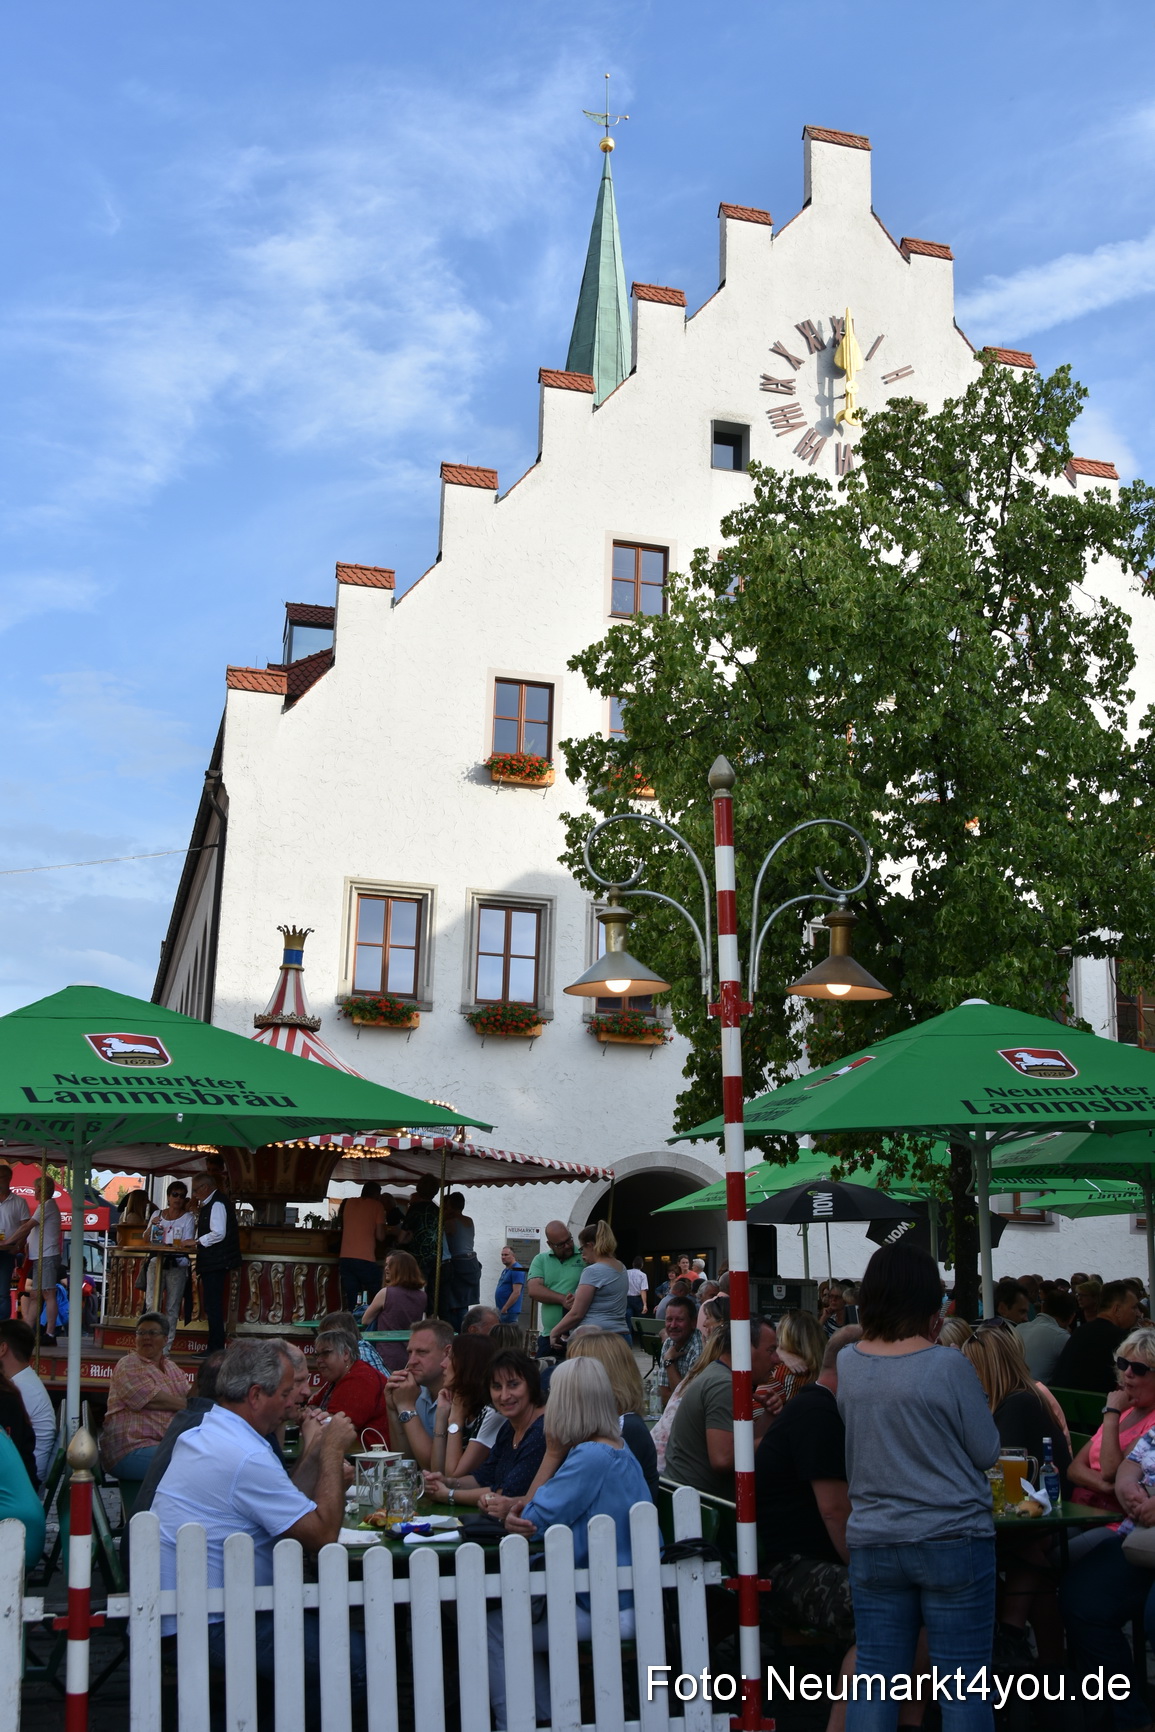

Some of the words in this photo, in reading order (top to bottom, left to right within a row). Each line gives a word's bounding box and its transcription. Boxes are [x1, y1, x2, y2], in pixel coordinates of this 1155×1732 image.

[123, 1058, 157, 1066] 1628
[52, 1073, 247, 1091] Neumarkter
[20, 1086, 299, 1108] Lammsbräu
[983, 1084, 1150, 1098] Neumarkter
[90, 1364, 113, 1377] Mich
